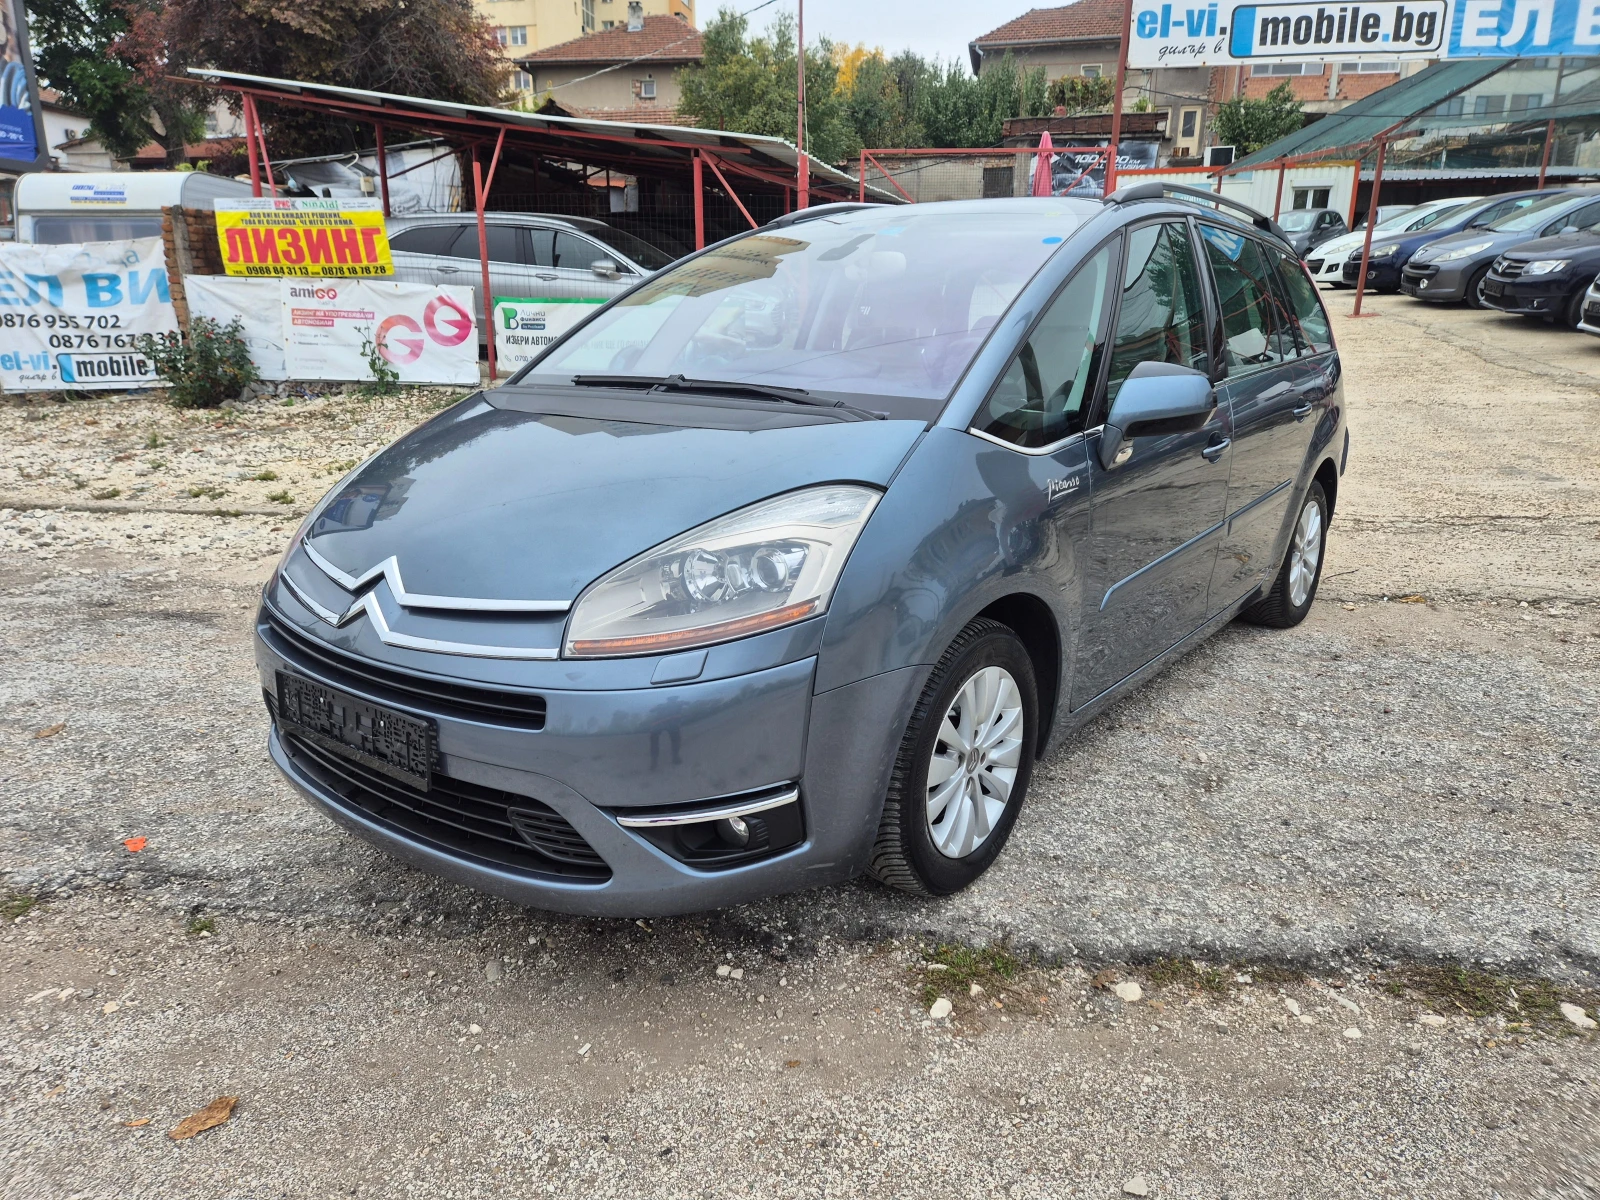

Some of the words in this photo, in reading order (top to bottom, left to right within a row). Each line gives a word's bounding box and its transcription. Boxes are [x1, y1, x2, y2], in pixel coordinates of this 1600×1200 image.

[1259, 6, 1438, 46] mobile.bg
[1460, 0, 1555, 47] ЕЛ
[1158, 42, 1206, 61] дилър
[1213, 37, 1225, 53] в
[225, 227, 382, 264] ЛИЗИНГ
[246, 266, 272, 275] 0988
[272, 266, 285, 275] 84
[286, 266, 297, 275] 31
[298, 266, 309, 276] 13
[321, 266, 345, 275] 0878
[346, 266, 358, 275] 18
[359, 266, 372, 275] 78
[372, 265, 387, 275] 28
[0, 270, 63, 307] ЕЛ
[82, 268, 171, 308] ВИ
[44, 314, 79, 329] 955
[84, 315, 121, 329] 702
[49, 335, 99, 349] 0876
[505, 335, 530, 345] ИЗБЕРИ
